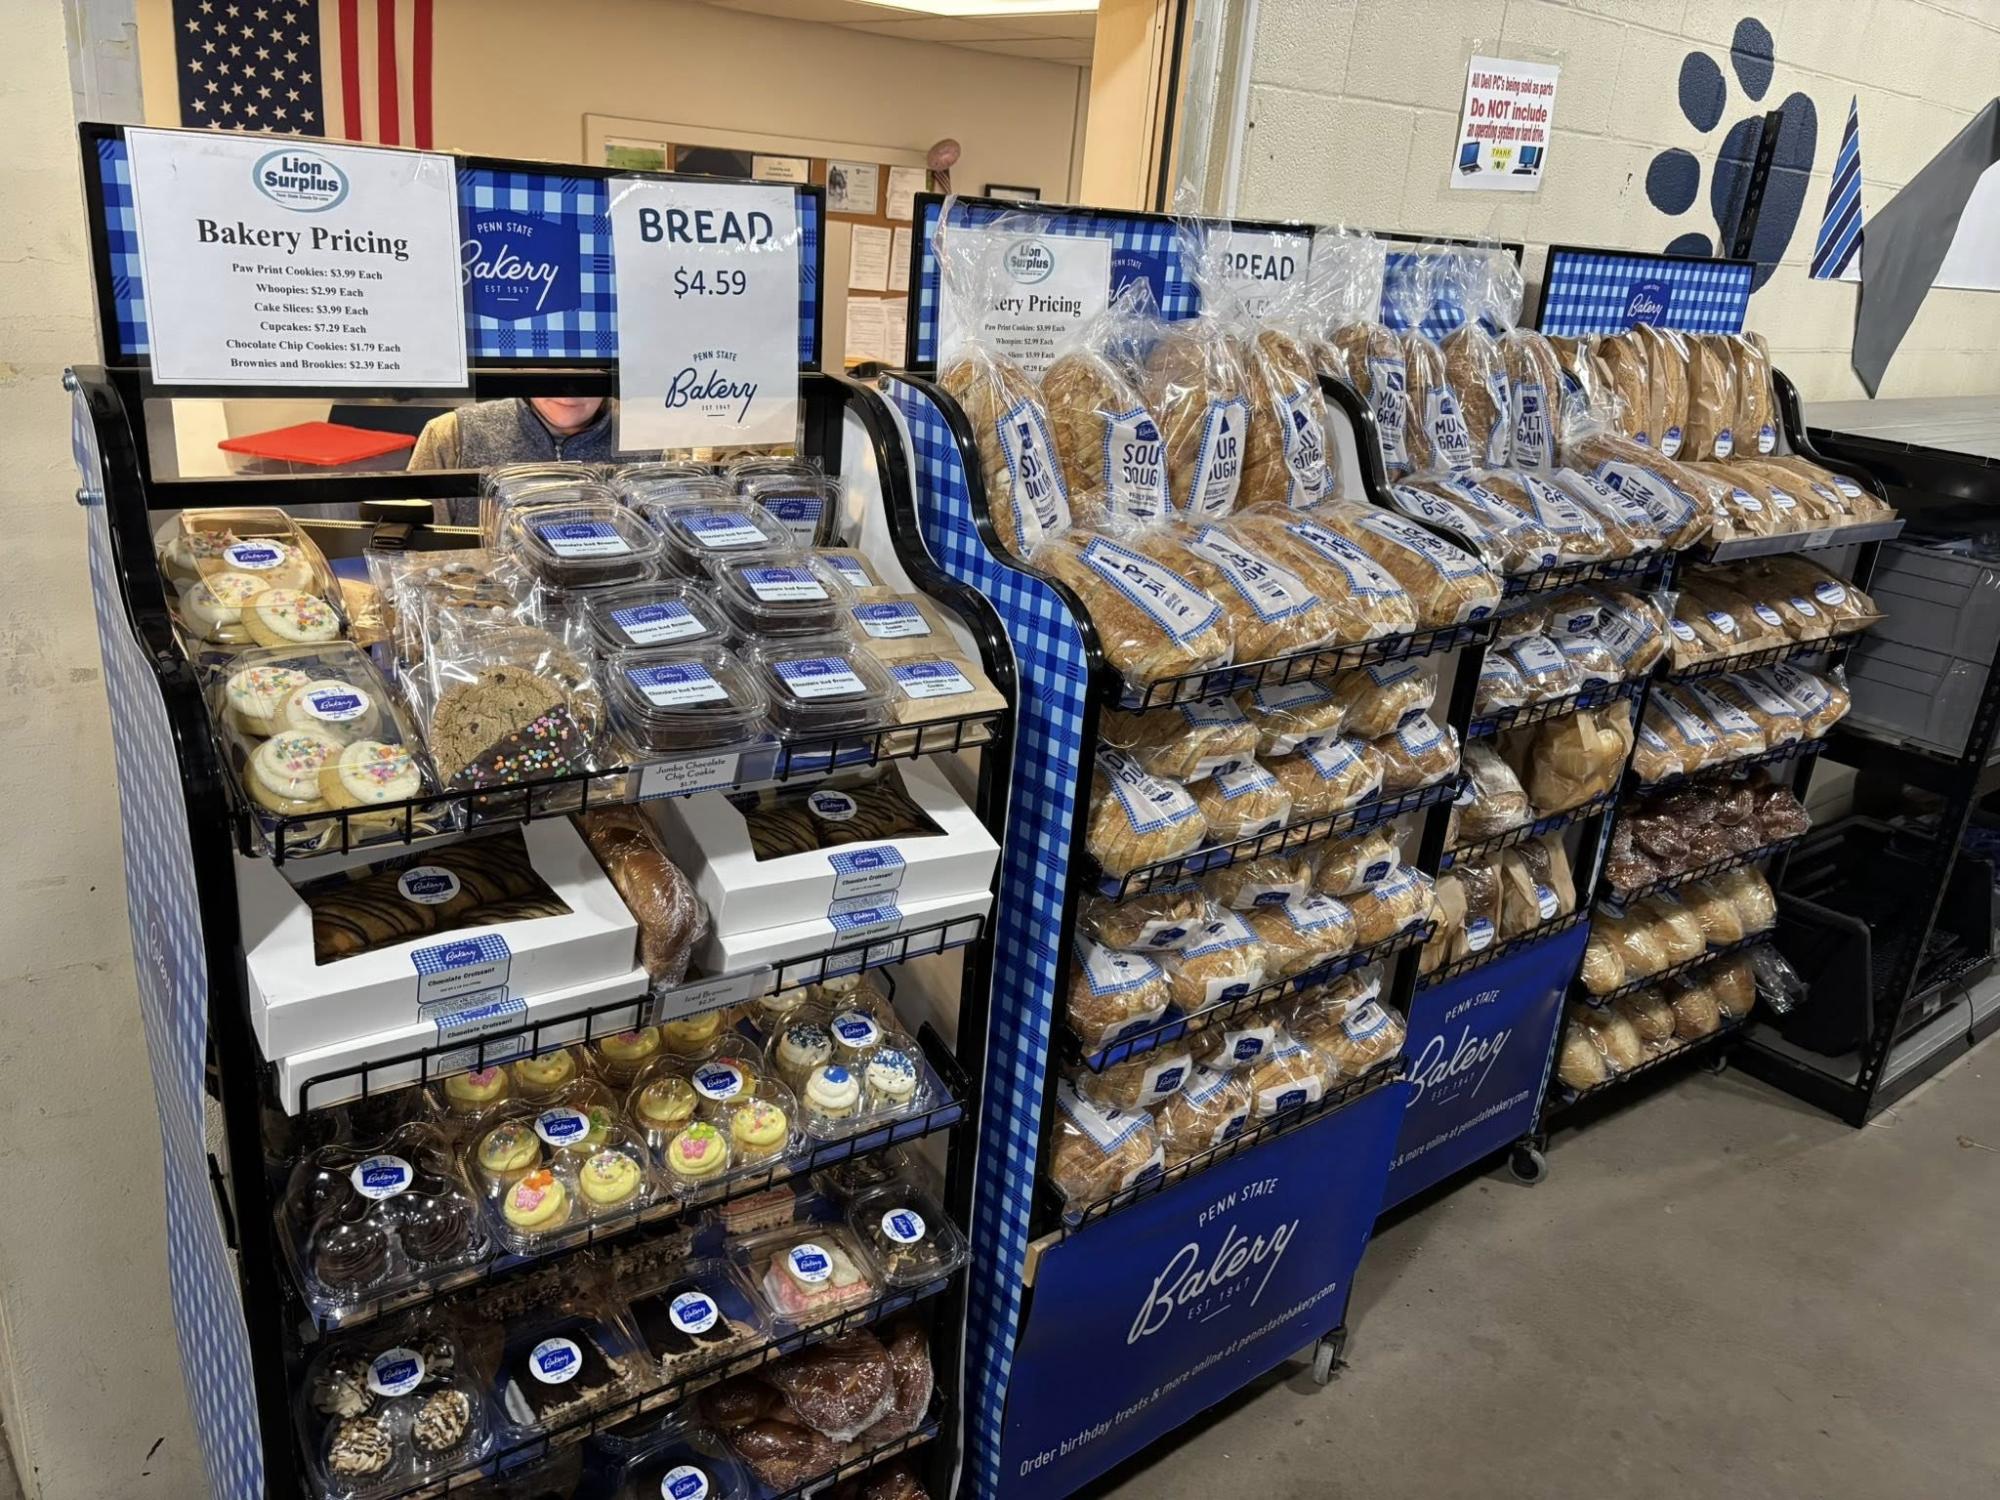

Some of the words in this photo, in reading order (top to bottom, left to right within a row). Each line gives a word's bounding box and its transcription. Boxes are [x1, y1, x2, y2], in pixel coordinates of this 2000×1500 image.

[1471, 72, 1481, 88] All
[1481, 73, 1492, 89] Dell
[1506, 75, 1520, 96] being
[1521, 78, 1533, 93] sold
[1533, 83, 1539, 94] as
[1539, 82, 1554, 98] parts
[1470, 98, 1485, 117] Do
[1487, 99, 1511, 119] NOT
[1512, 101, 1547, 123] include
[1467, 123, 1475, 137] an
[1475, 121, 1498, 144] operating
[1497, 122, 1515, 144] system
[1521, 123, 1532, 141] hard
[282, 157, 322, 175] Lion
[264, 172, 339, 193] Surplus
[477, 221, 503, 234] PENN
[506, 222, 534, 238] STATE
[639, 208, 773, 245] BREAD
[197, 219, 301, 254] Bakery
[310, 227, 409, 262] Pricing
[232, 263, 253, 273] Paw
[257, 265, 283, 275] Print
[286, 266, 328, 277] Cookies:
[330, 268, 356, 279] $3.99
[359, 270, 383, 280] Each
[1010, 256, 1050, 271] Surplus
[1223, 253, 1295, 281] BREAD
[460, 239, 559, 311] Bakery
[674, 266, 747, 299] $4.59
[256, 283, 309, 296] Whoopies:
[311, 286, 337, 296] $2.99
[340, 288, 364, 297] Each
[485, 285, 501, 294] EST
[507, 286, 530, 294] 1947
[254, 302, 281, 312] Cake
[283, 303, 314, 314] Slices:
[316, 305, 342, 315] $3.99
[345, 306, 369, 316] Each
[1029, 295, 1081, 317] Pricing
[1627, 293, 1662, 327] Bakery
[260, 321, 312, 333] Cupcakes:
[314, 323, 340, 333] $7.29
[343, 324, 367, 334] Each
[1012, 324, 1035, 332] Cookies:
[1036, 324, 1051, 332] $3.99
[226, 339, 276, 350] Chocolate
[279, 340, 303, 352] Chip
[306, 341, 348, 352] Cookies:
[350, 343, 375, 352] $1.79
[378, 344, 401, 353] Each
[1024, 338, 1039, 346] $2.99
[1040, 338, 1054, 346] Each
[231, 358, 278, 368] Brownies
[280, 359, 299, 369] and
[302, 360, 347, 370] Brookies:
[350, 361, 374, 371] $2.39
[377, 361, 400, 371] Each
[693, 350, 714, 363] PENN
[716, 350, 738, 362] STATE
[665, 367, 758, 424] Bakery
[656, 764, 683, 774] Jumbo
[685, 758, 726, 770] Chocolate
[687, 768, 716, 778] Cookie
[413, 881, 445, 892] Bakery
[445, 949, 476, 961] Bakery
[428, 975, 461, 987] Chocolate
[463, 967, 495, 979] Croissant
[1445, 999, 1472, 1024] PENN
[1473, 990, 1500, 1007] STATE
[447, 1027, 480, 1039] Chocolate
[482, 1018, 512, 1030] Croissant
[1405, 1025, 1512, 1108] Bakery
[549, 1123, 578, 1135] Bakery
[1405, 1144, 1424, 1162] more
[1426, 1132, 1448, 1152] online
[1449, 1126, 1458, 1139] at
[1458, 1090, 1529, 1137] pennstatebakery.com
[367, 1174, 398, 1184] Bakery
[1199, 1195, 1236, 1228] PENN
[1242, 1178, 1279, 1201] STATE
[1127, 1219, 1299, 1345] Bakery
[1188, 1299, 1211, 1320] EST
[1219, 1277, 1251, 1301] 1947
[383, 1366, 412, 1381] Bakery
[1019, 1449, 1057, 1477] Order
[1060, 1419, 1112, 1456] birthday
[1115, 1397, 1149, 1422] treats
[1150, 1388, 1162, 1403] &
[1162, 1371, 1190, 1396] more
[1192, 1350, 1224, 1377] online
[1224, 1340, 1237, 1358] at
[1238, 1281, 1336, 1353] pennstatebakery.com
